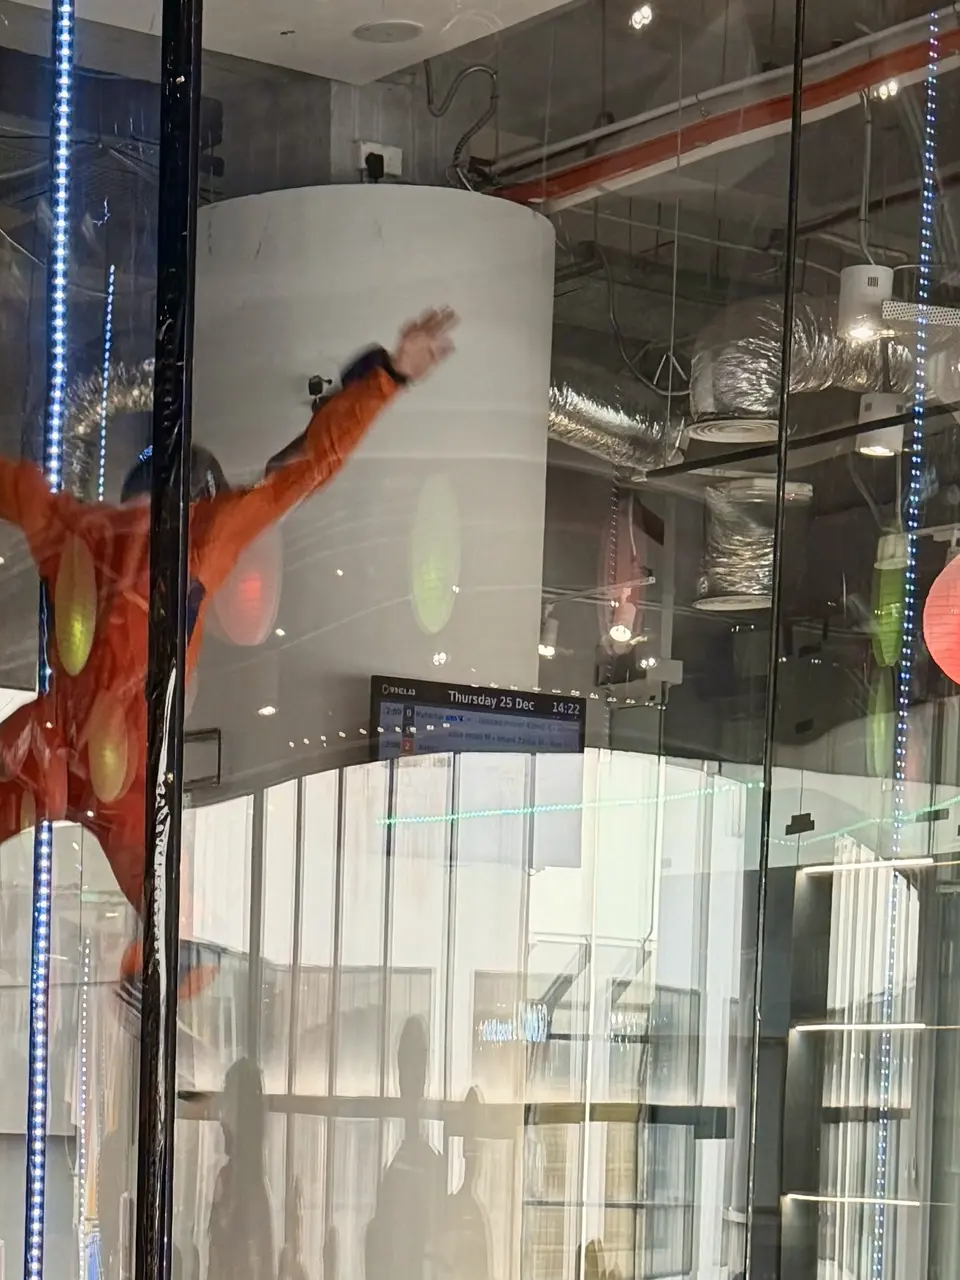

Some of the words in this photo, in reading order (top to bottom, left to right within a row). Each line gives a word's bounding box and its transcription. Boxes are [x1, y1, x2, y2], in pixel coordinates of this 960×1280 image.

[448, 690, 496, 709] Thursday
[500, 696, 513, 709] 25
[516, 698, 535, 711] Dec
[552, 701, 580, 715] 14:22
